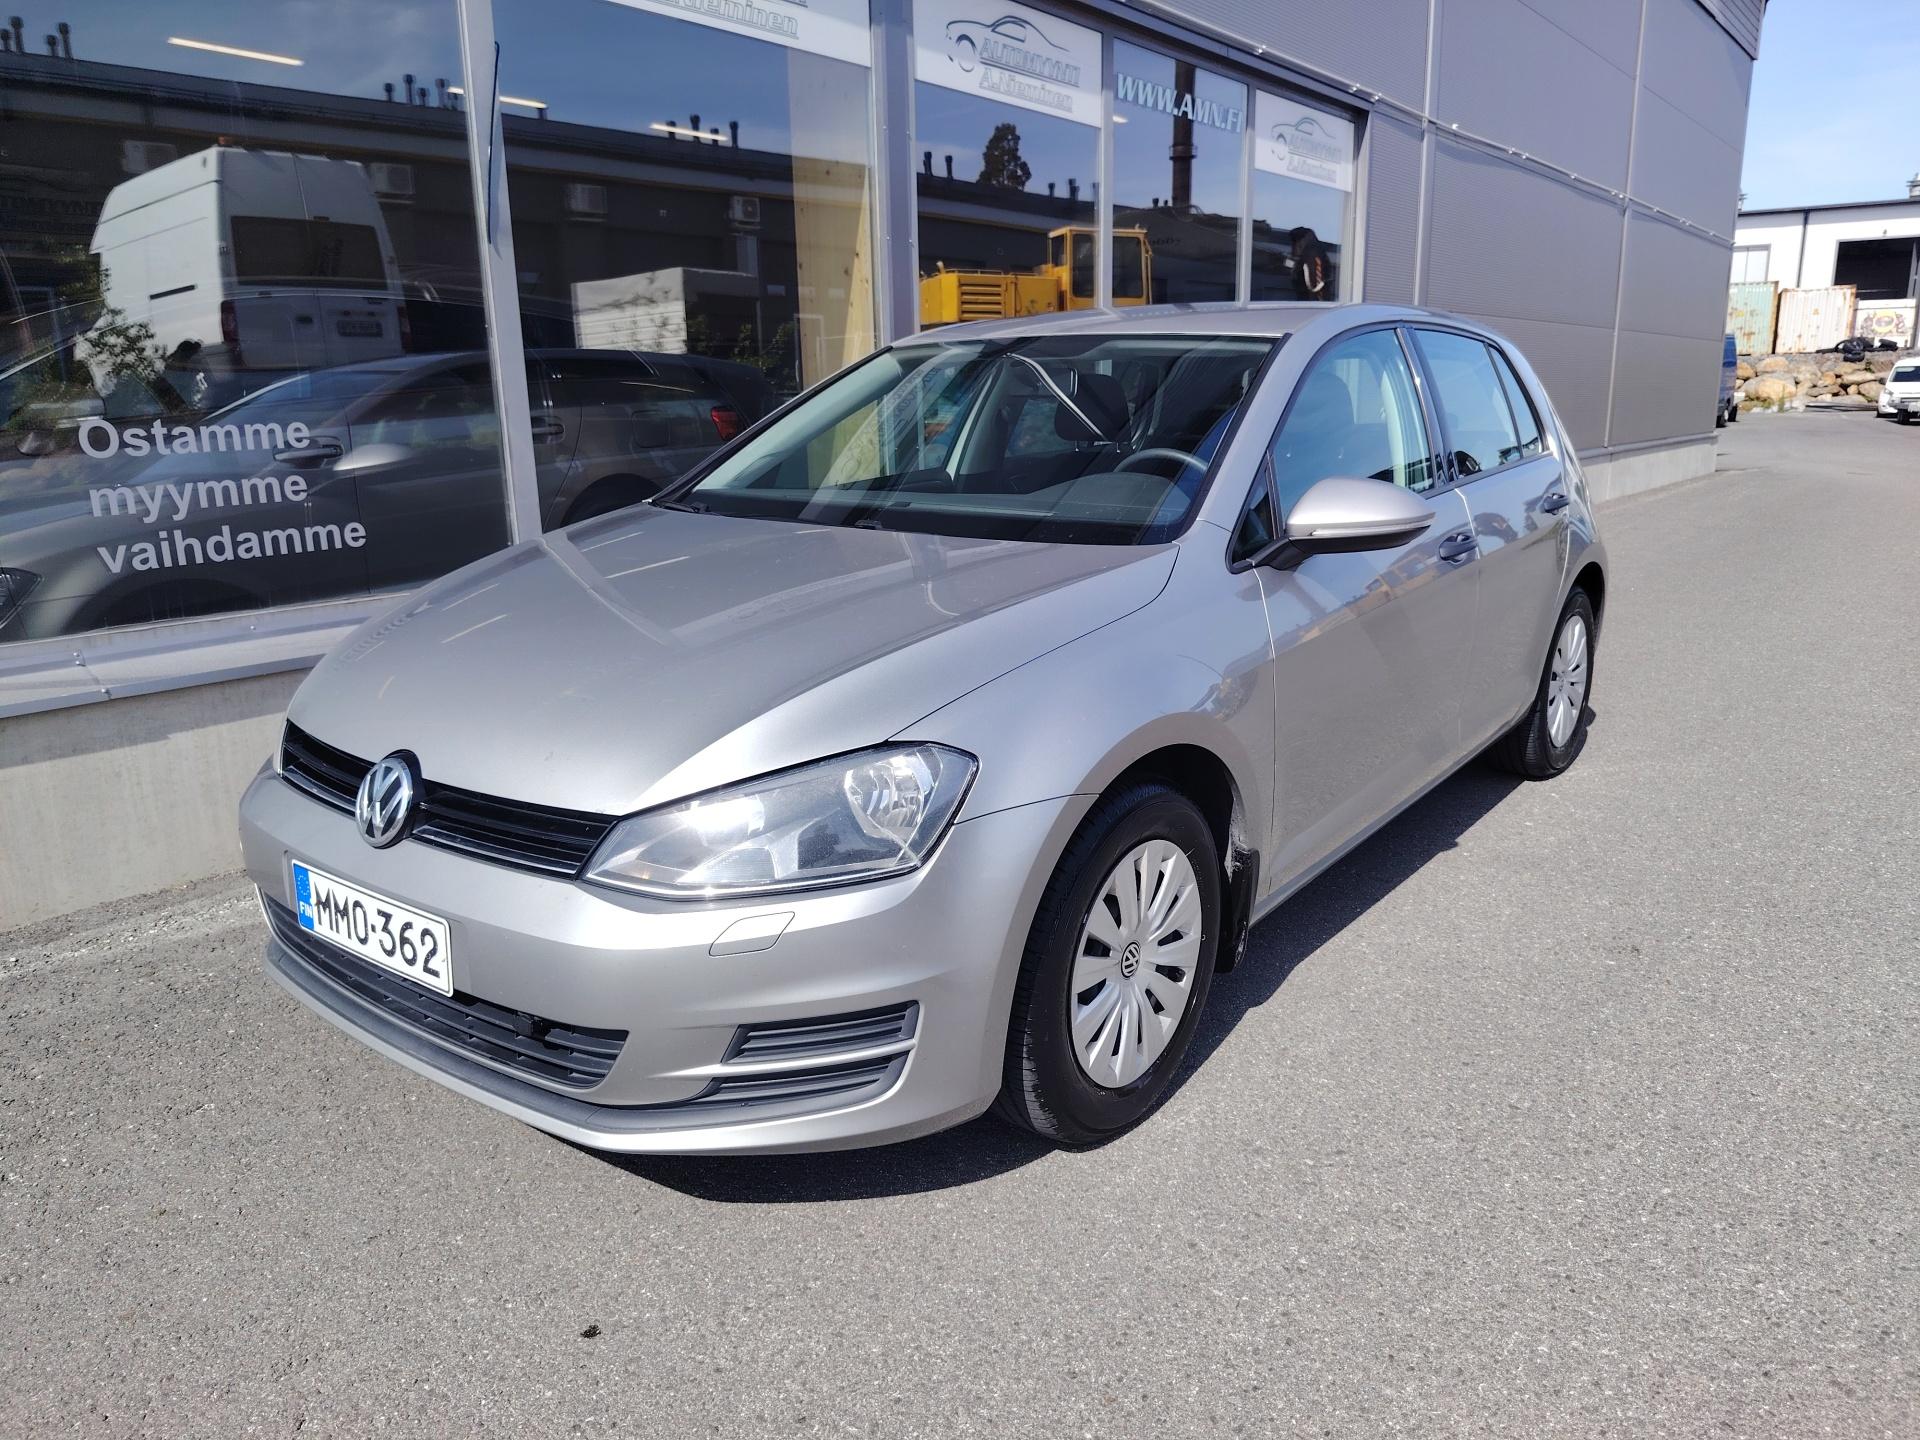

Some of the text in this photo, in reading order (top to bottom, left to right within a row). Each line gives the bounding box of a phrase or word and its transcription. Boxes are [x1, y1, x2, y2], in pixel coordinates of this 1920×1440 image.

[979, 37, 1081, 87] AUTOMYYNTI
[979, 67, 1073, 110] A.Nieminen
[1117, 72, 1243, 133] WWW.AMN.FI
[78, 419, 311, 458] Ostamme
[89, 474, 308, 524] myymme
[97, 521, 367, 574] vaihdamme
[300, 902, 314, 919] FIN
[314, 882, 440, 978] MMO-362
